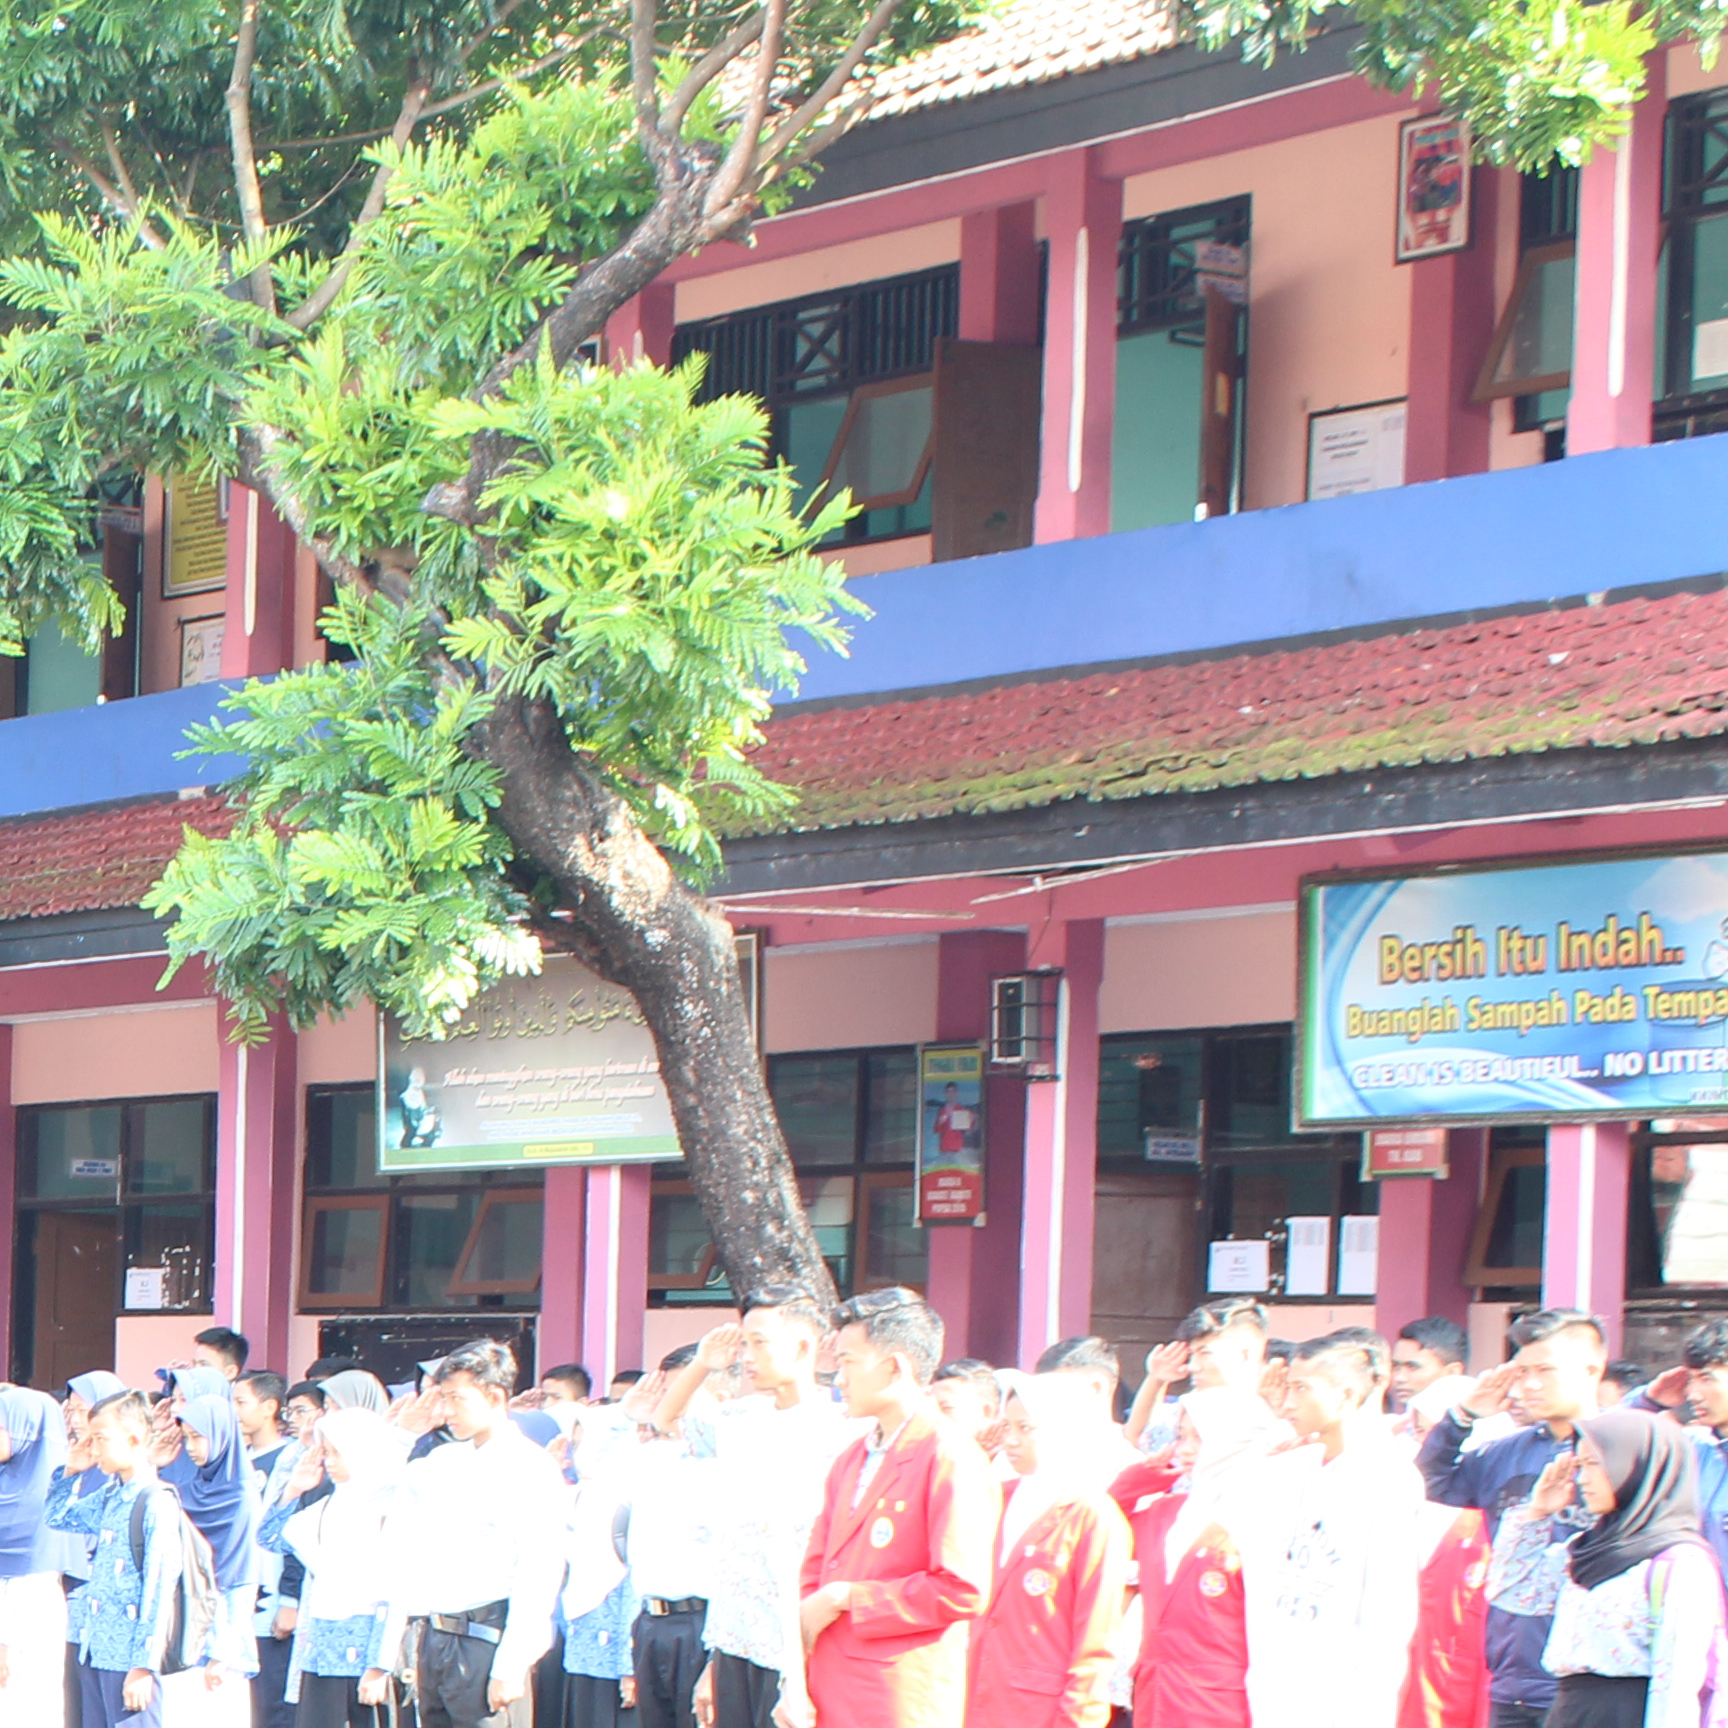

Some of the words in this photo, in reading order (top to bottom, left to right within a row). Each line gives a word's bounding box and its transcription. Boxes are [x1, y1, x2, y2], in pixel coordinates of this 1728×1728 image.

[1379, 925, 1487, 985] Bersih
[1496, 926, 1547, 977] Itu
[1346, 995, 1460, 1044] Buanglah
[1465, 988, 1568, 1037] Sampah
[1572, 984, 1638, 1026] Pada
[1641, 985, 1728, 1027] Tempa
[1354, 1062, 1427, 1090] CLEAN
[1430, 1060, 1455, 1086] IS
[1604, 1051, 1645, 1077] NO
[1648, 1047, 1728, 1076] LITTER
